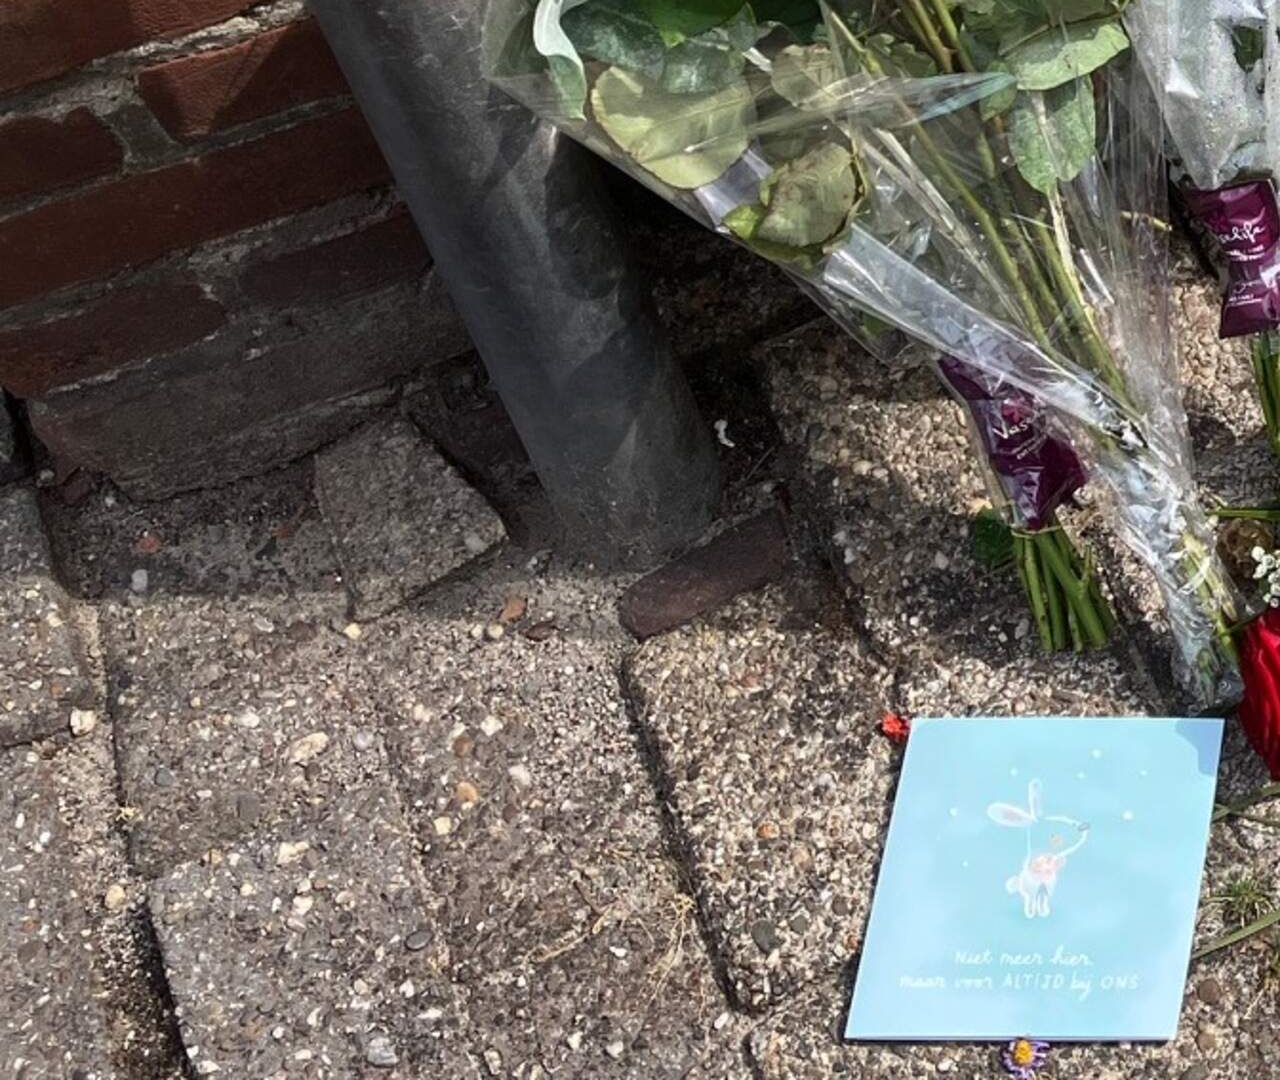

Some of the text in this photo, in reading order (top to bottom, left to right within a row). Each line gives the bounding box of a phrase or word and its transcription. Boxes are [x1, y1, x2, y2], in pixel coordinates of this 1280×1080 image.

[1000, 952, 1043, 965] meer
[1000, 972, 1064, 989] ALTIJD
[1100, 975, 1138, 990] ONS
